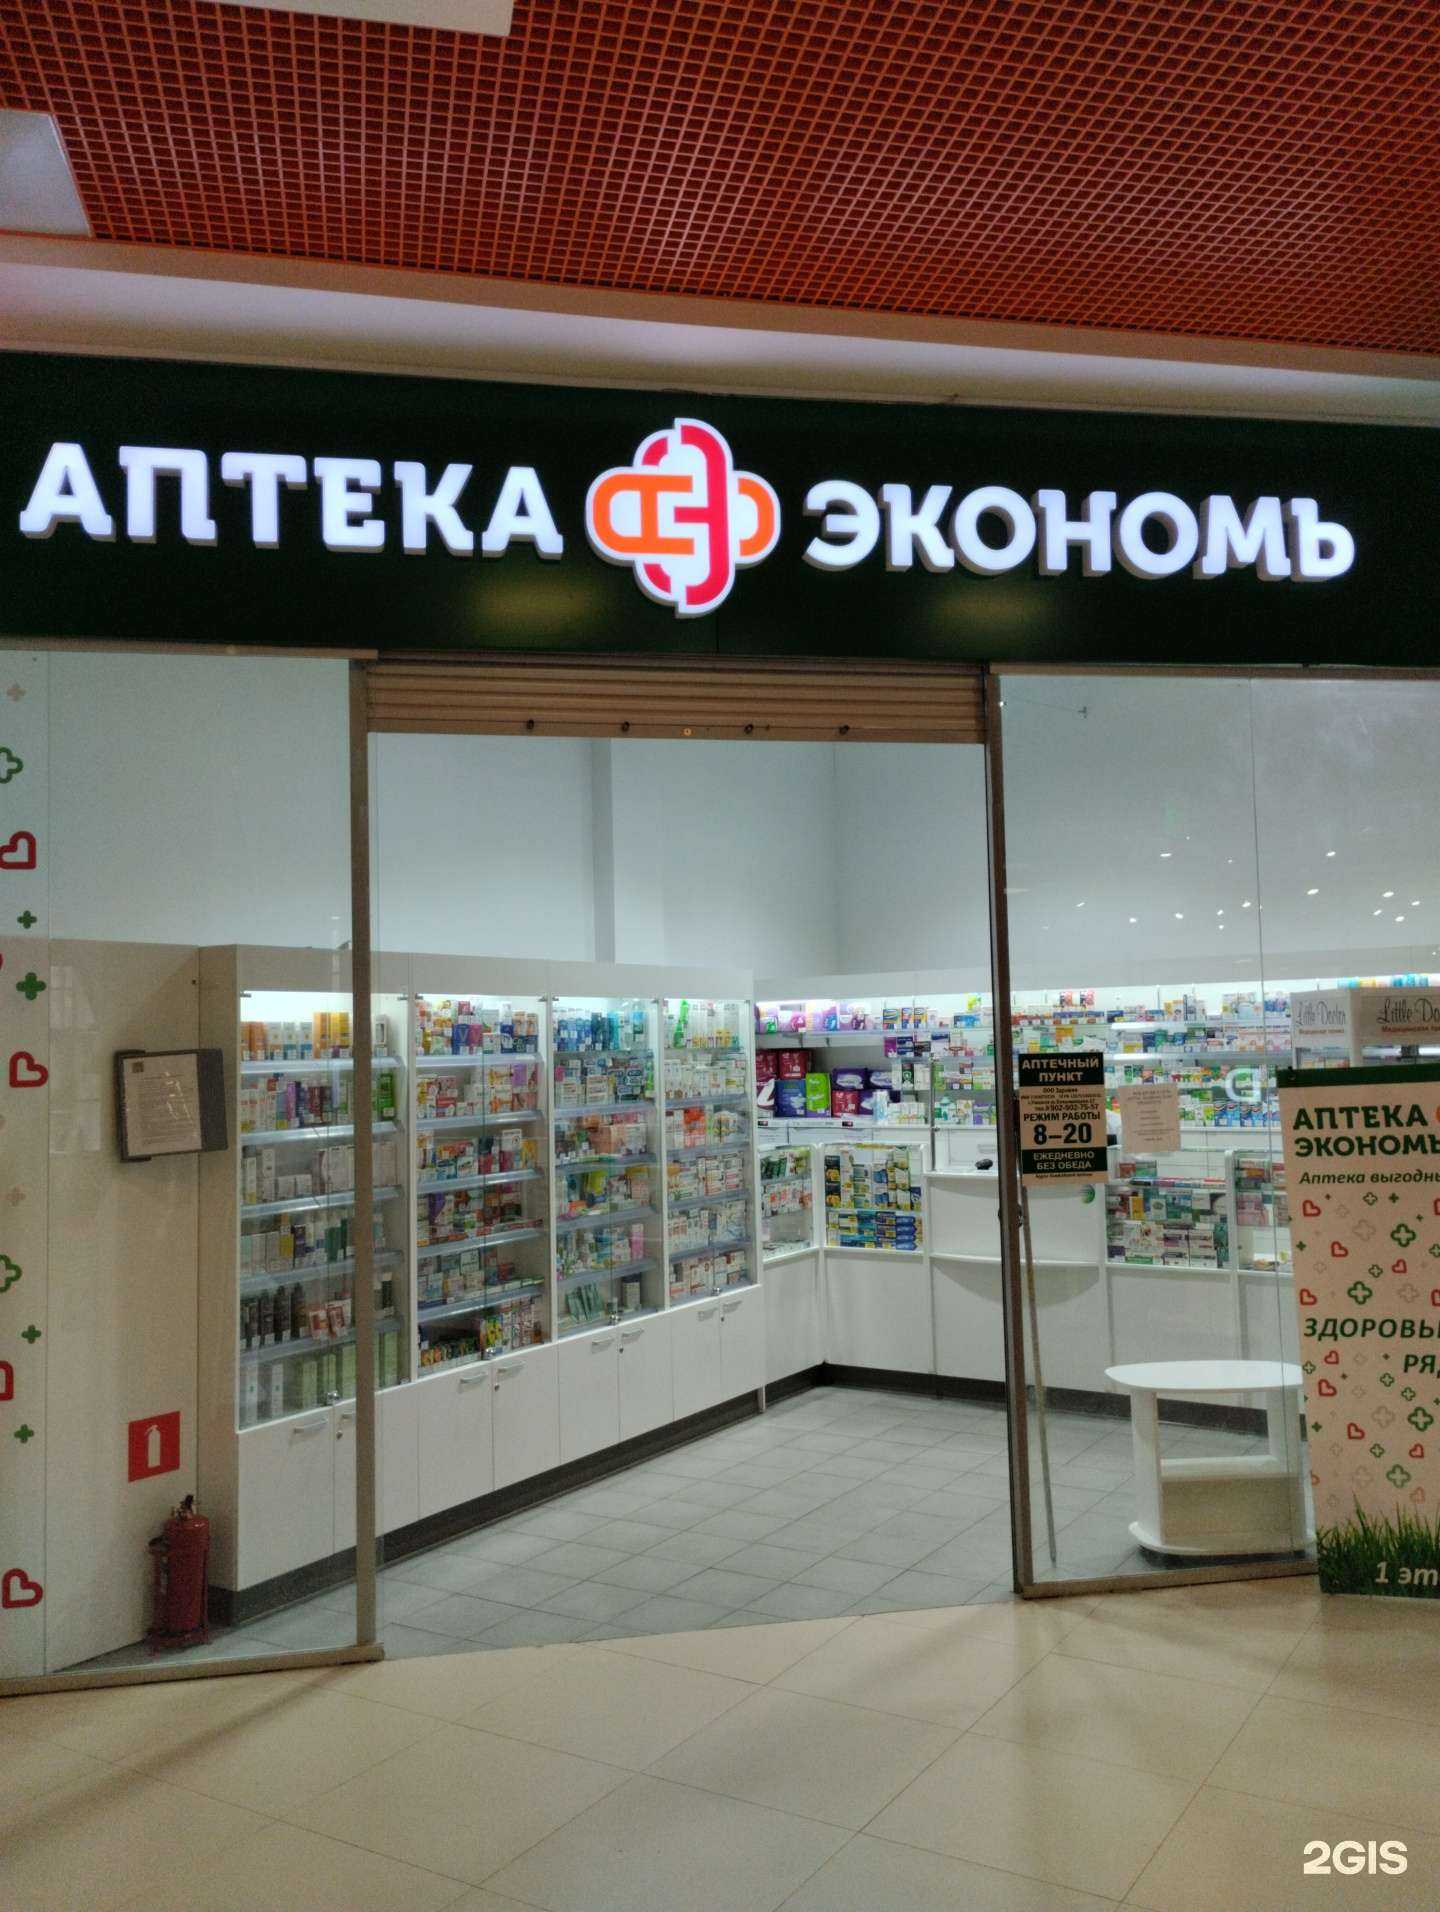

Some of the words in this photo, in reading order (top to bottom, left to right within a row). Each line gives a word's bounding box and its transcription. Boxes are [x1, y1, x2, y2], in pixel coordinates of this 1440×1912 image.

[20, 442, 564, 559] АПТЕКА
[1022, 1056, 1099, 1069] АПТЕЧНЫЙ
[1039, 1071, 1083, 1082] ПУНКТ
[1024, 1112, 1060, 1121] РЕЖИМ
[1062, 1112, 1100, 1121] РАБОТЫ
[1293, 1104, 1428, 1130] АПТЕКА
[1033, 1151, 1095, 1161] ЕЖЕДНЕВНО
[1036, 1162, 1056, 1170] БЕЗ
[1058, 1161, 1092, 1170] ОБЕДА
[1299, 1172, 1365, 1184] Аптека
[1304, 1318, 1440, 1341] ЗДОРОВЬ
[1403, 1354, 1440, 1378] РЯ
[1375, 1561, 1389, 1584] 1
